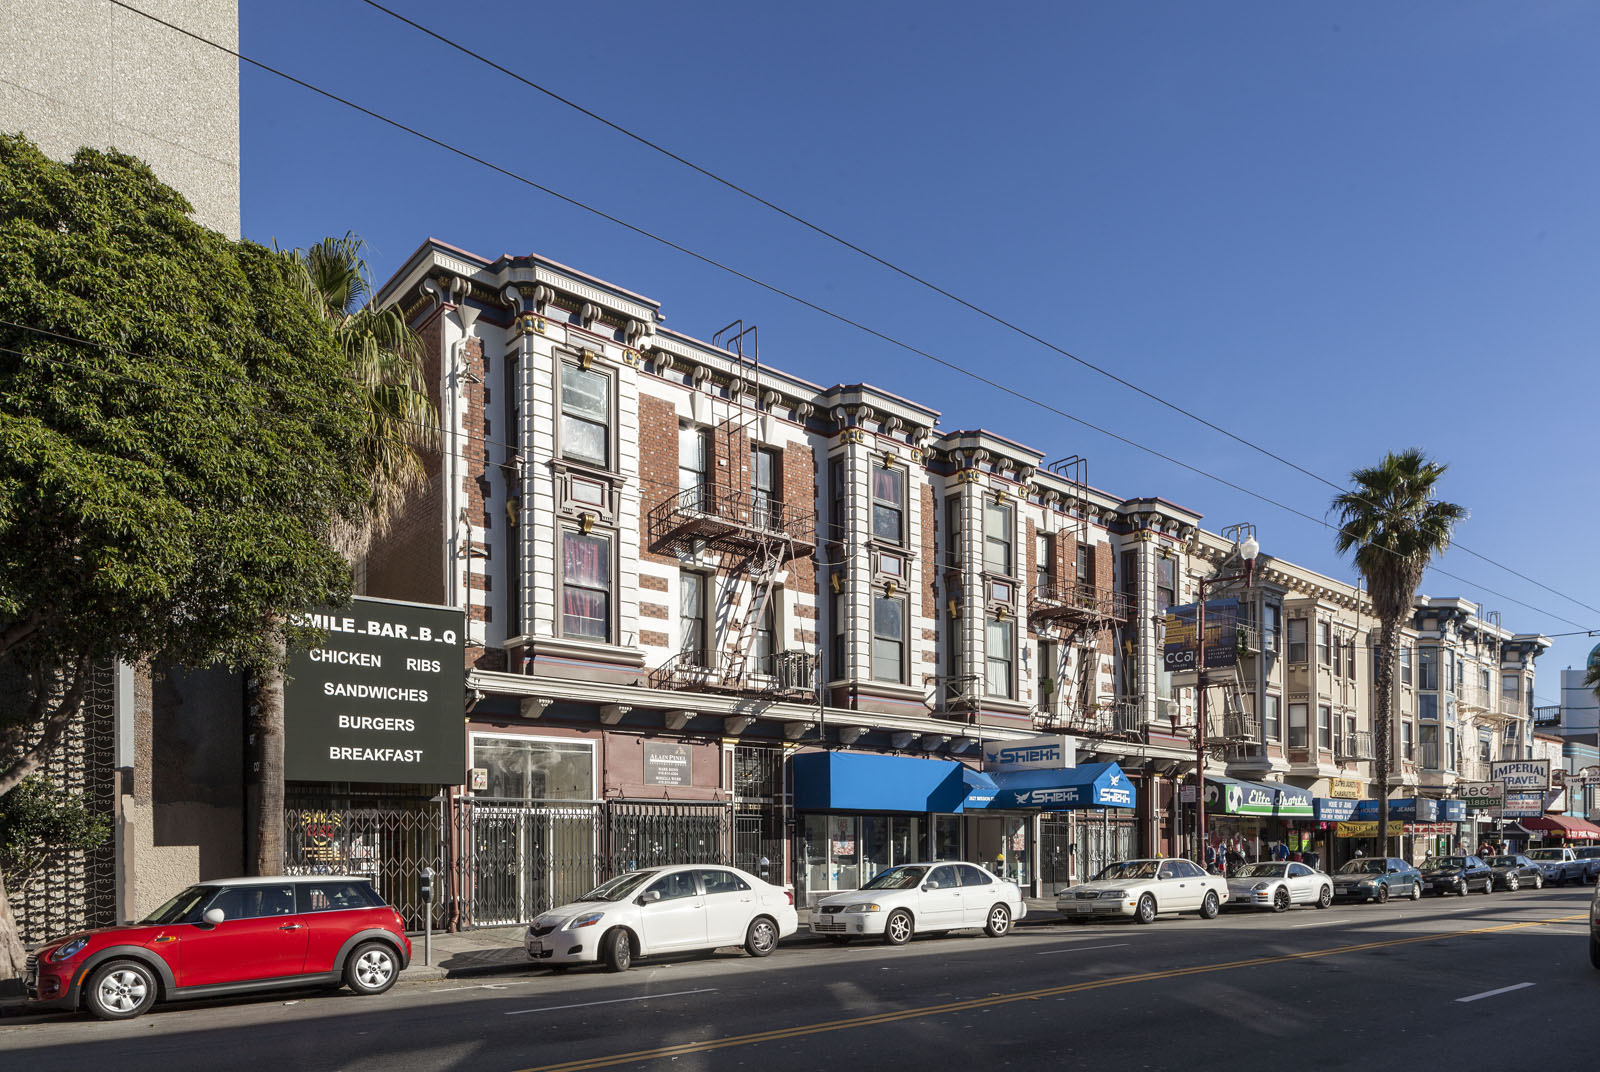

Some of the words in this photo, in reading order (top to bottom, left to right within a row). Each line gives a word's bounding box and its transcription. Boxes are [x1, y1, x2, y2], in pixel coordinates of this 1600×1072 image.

[309, 648, 382, 668] CHICKEN
[406, 658, 441, 673] RIBS
[323, 682, 429, 703] SANDWICHES
[338, 715, 415, 732] BURGERS
[329, 746, 423, 763] BREAKFAST
[1494, 763, 1547, 780] IMPERIAL
[1502, 776, 1539, 785] TRAVEL
[1248, 789, 1272, 805] Elite
[1278, 789, 1308, 810] Sports
